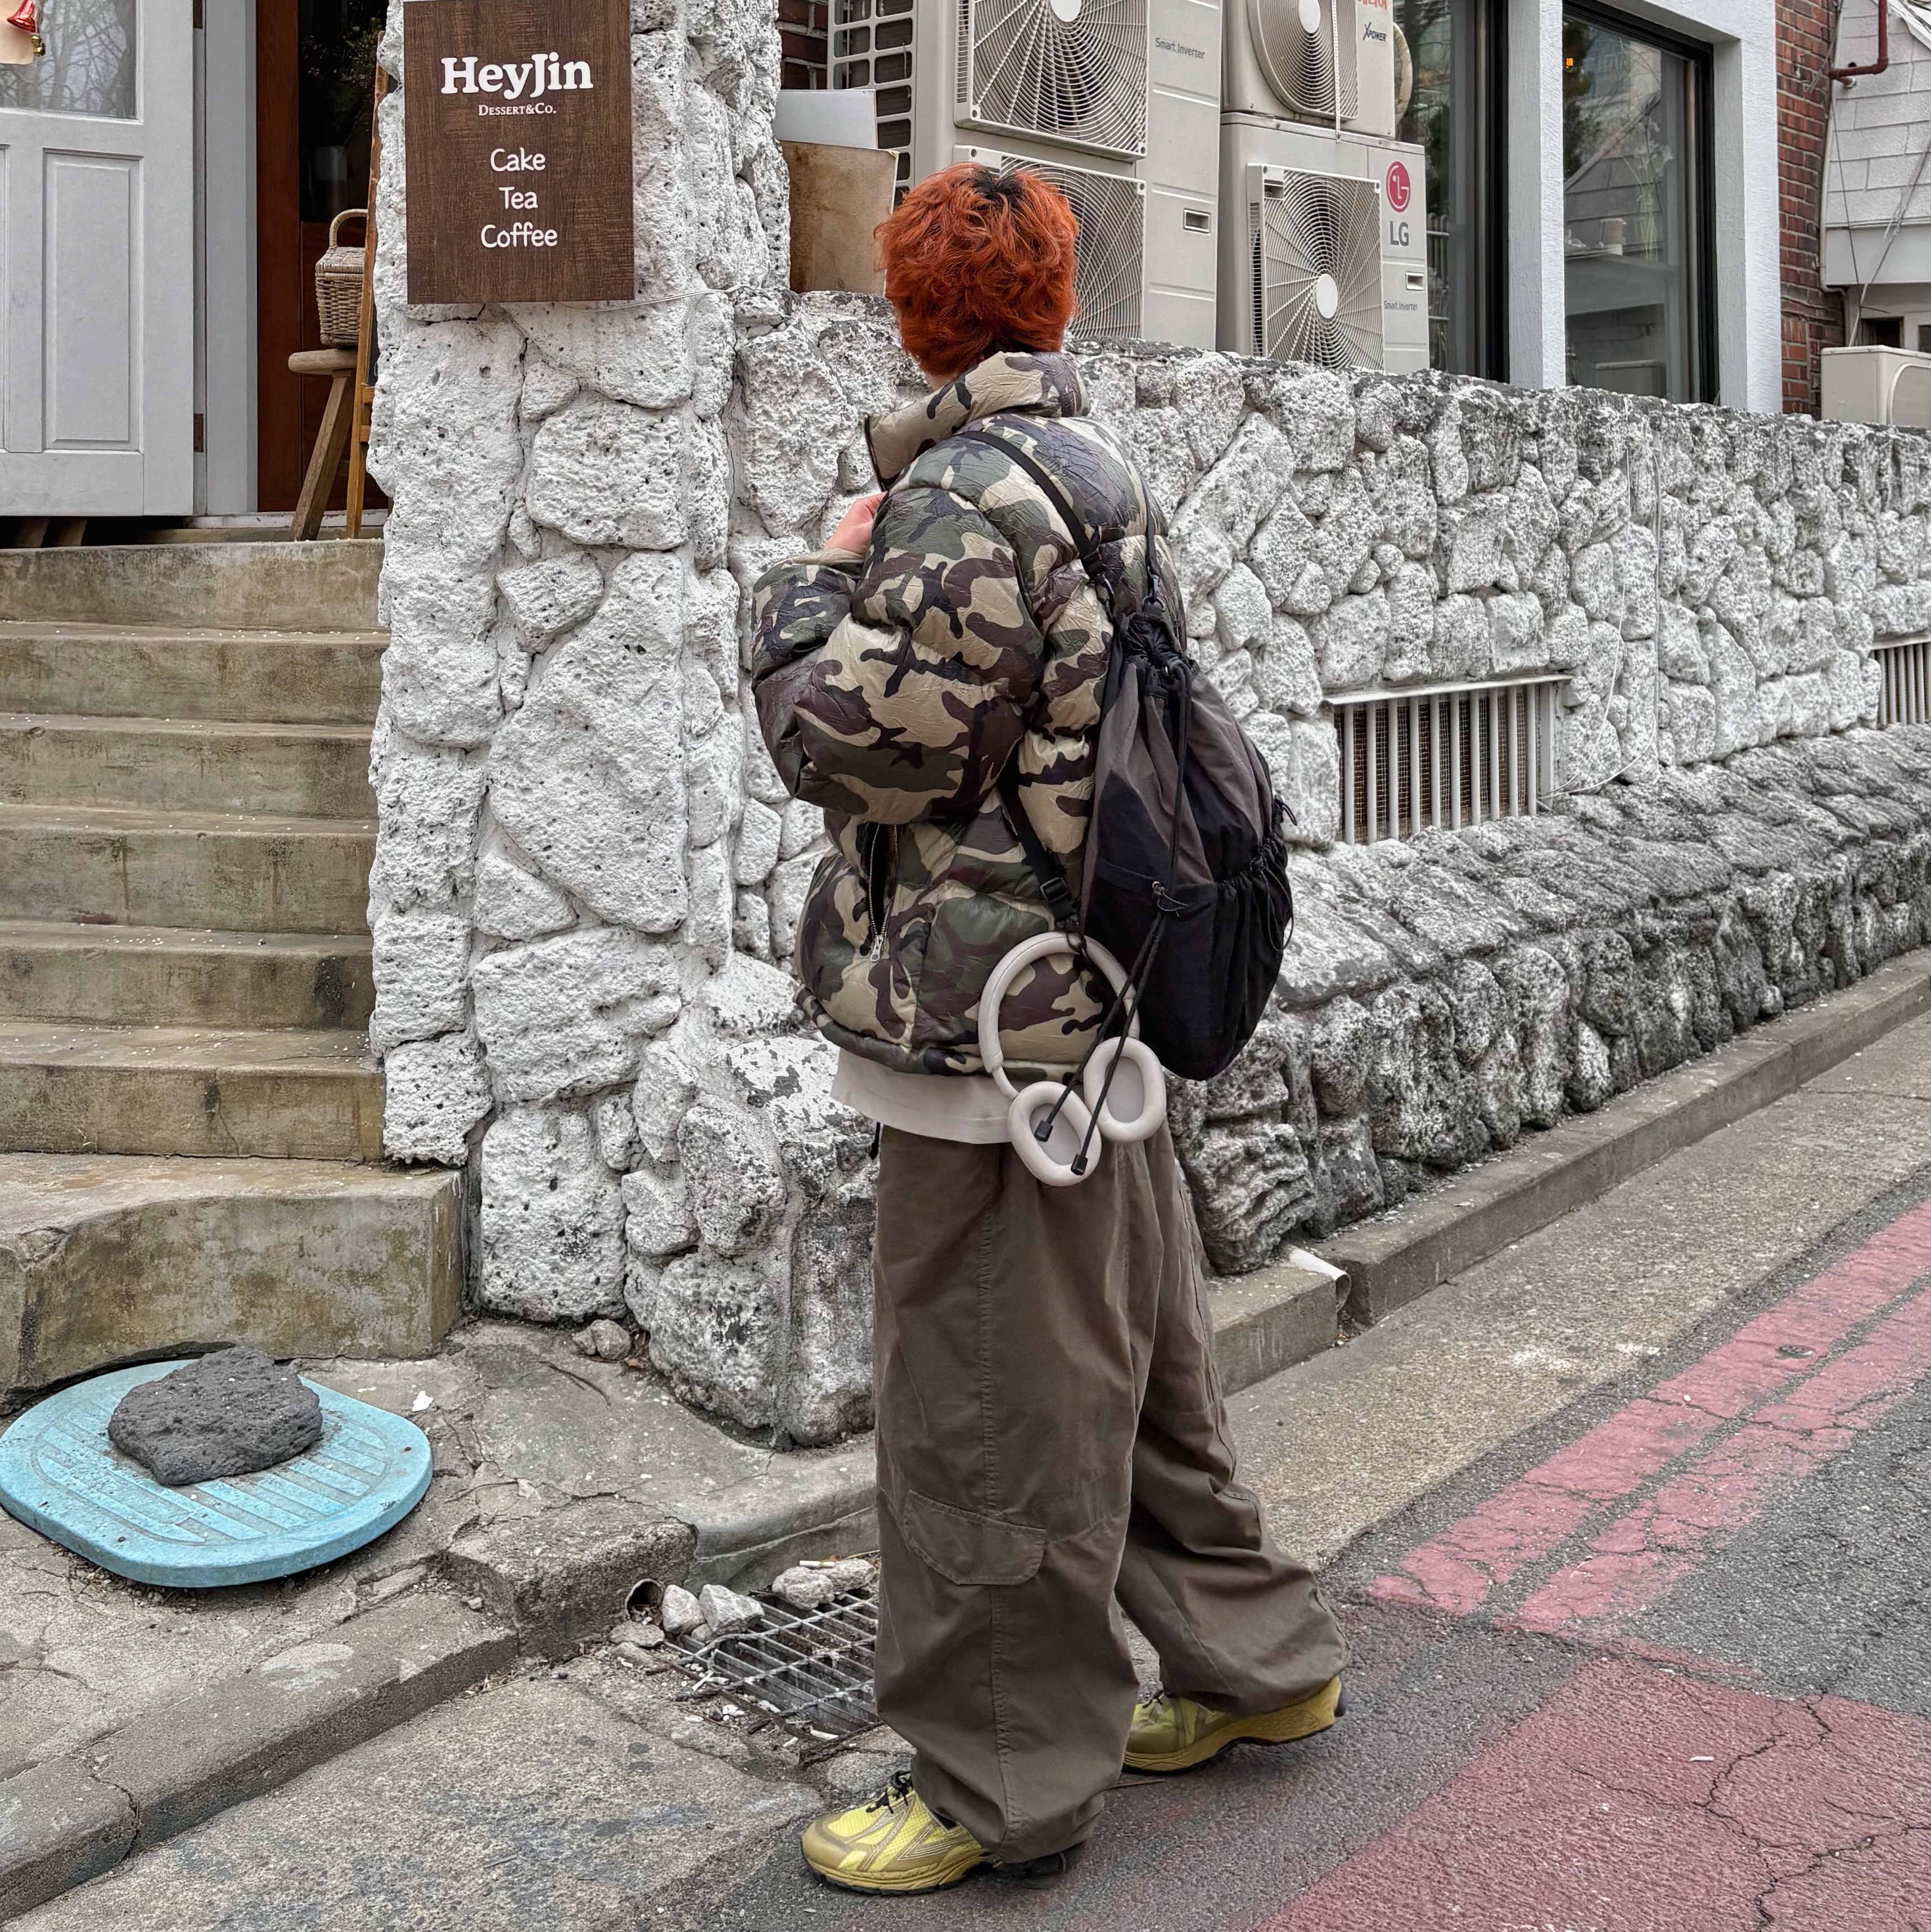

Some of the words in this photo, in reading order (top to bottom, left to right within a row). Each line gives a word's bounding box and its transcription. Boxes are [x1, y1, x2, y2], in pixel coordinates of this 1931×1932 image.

[1155, 37, 1176, 52] Smart
[1177, 43, 1205, 59] Inverter
[440, 51, 594, 100] HeyJin
[490, 147, 546, 171] Cake
[498, 186, 538, 209] Tea
[480, 222, 558, 248] Coffee
[1389, 220, 1409, 246] LG
[1384, 300, 1398, 310] Smart
[1399, 301, 1418, 311] Inverter
